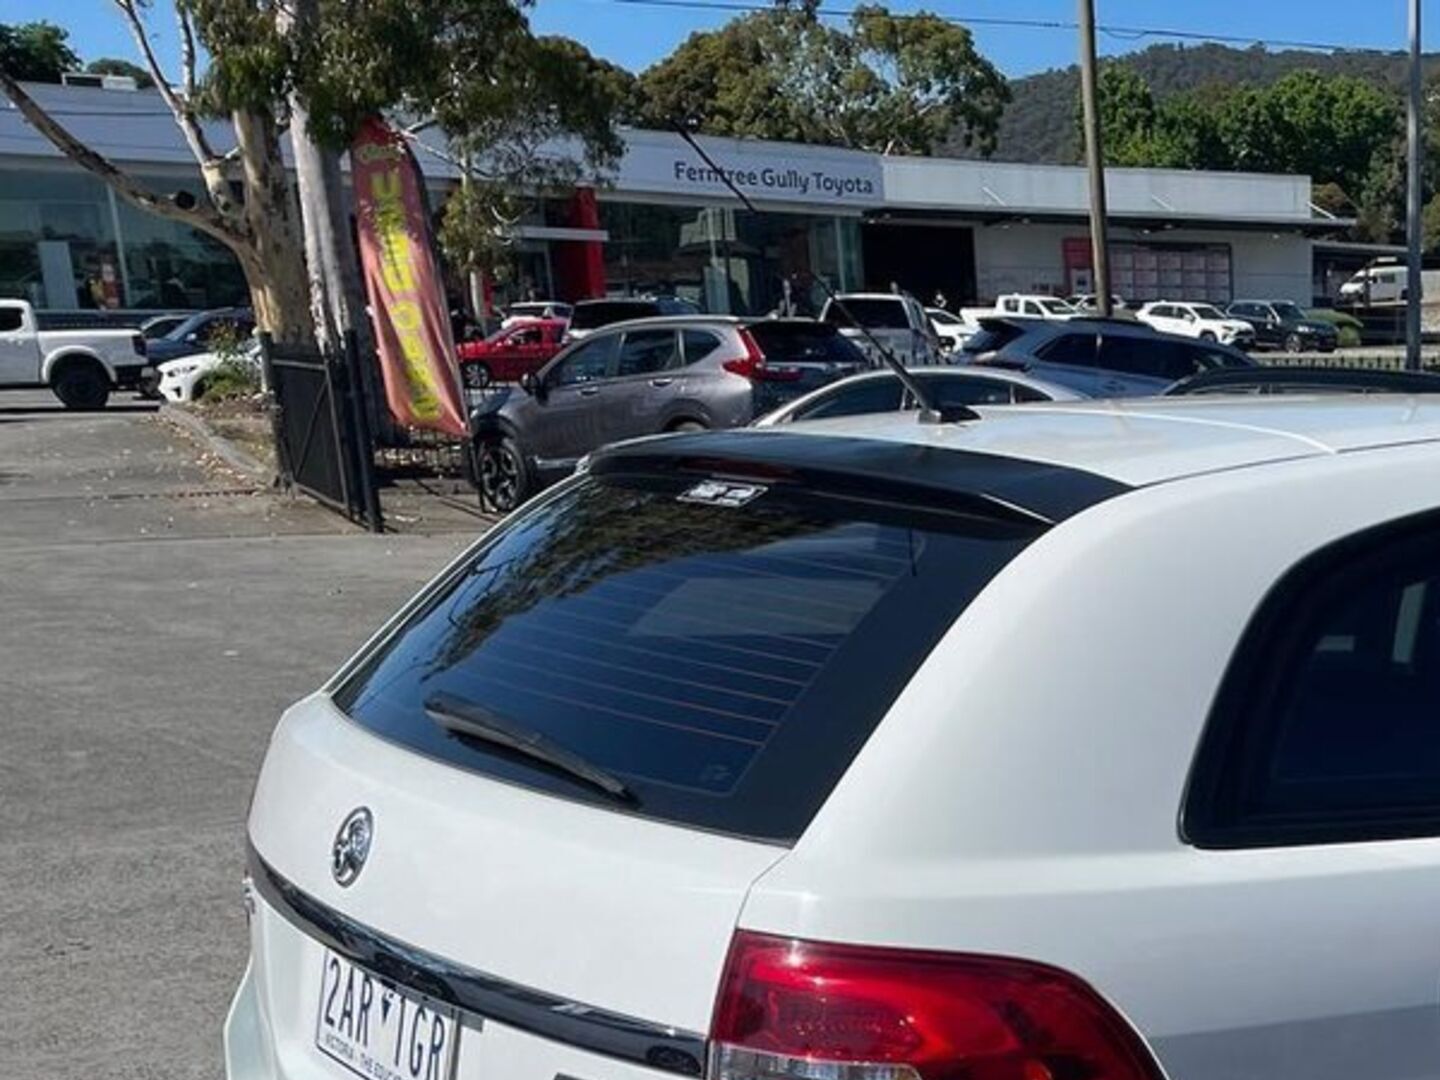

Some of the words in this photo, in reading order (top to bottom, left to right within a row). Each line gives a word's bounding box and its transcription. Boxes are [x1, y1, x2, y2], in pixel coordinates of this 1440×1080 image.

[674, 161, 758, 186] Ferntree
[760, 168, 810, 195] Gully
[812, 172, 873, 196] Toyota
[325, 957, 374, 1047] 2AR
